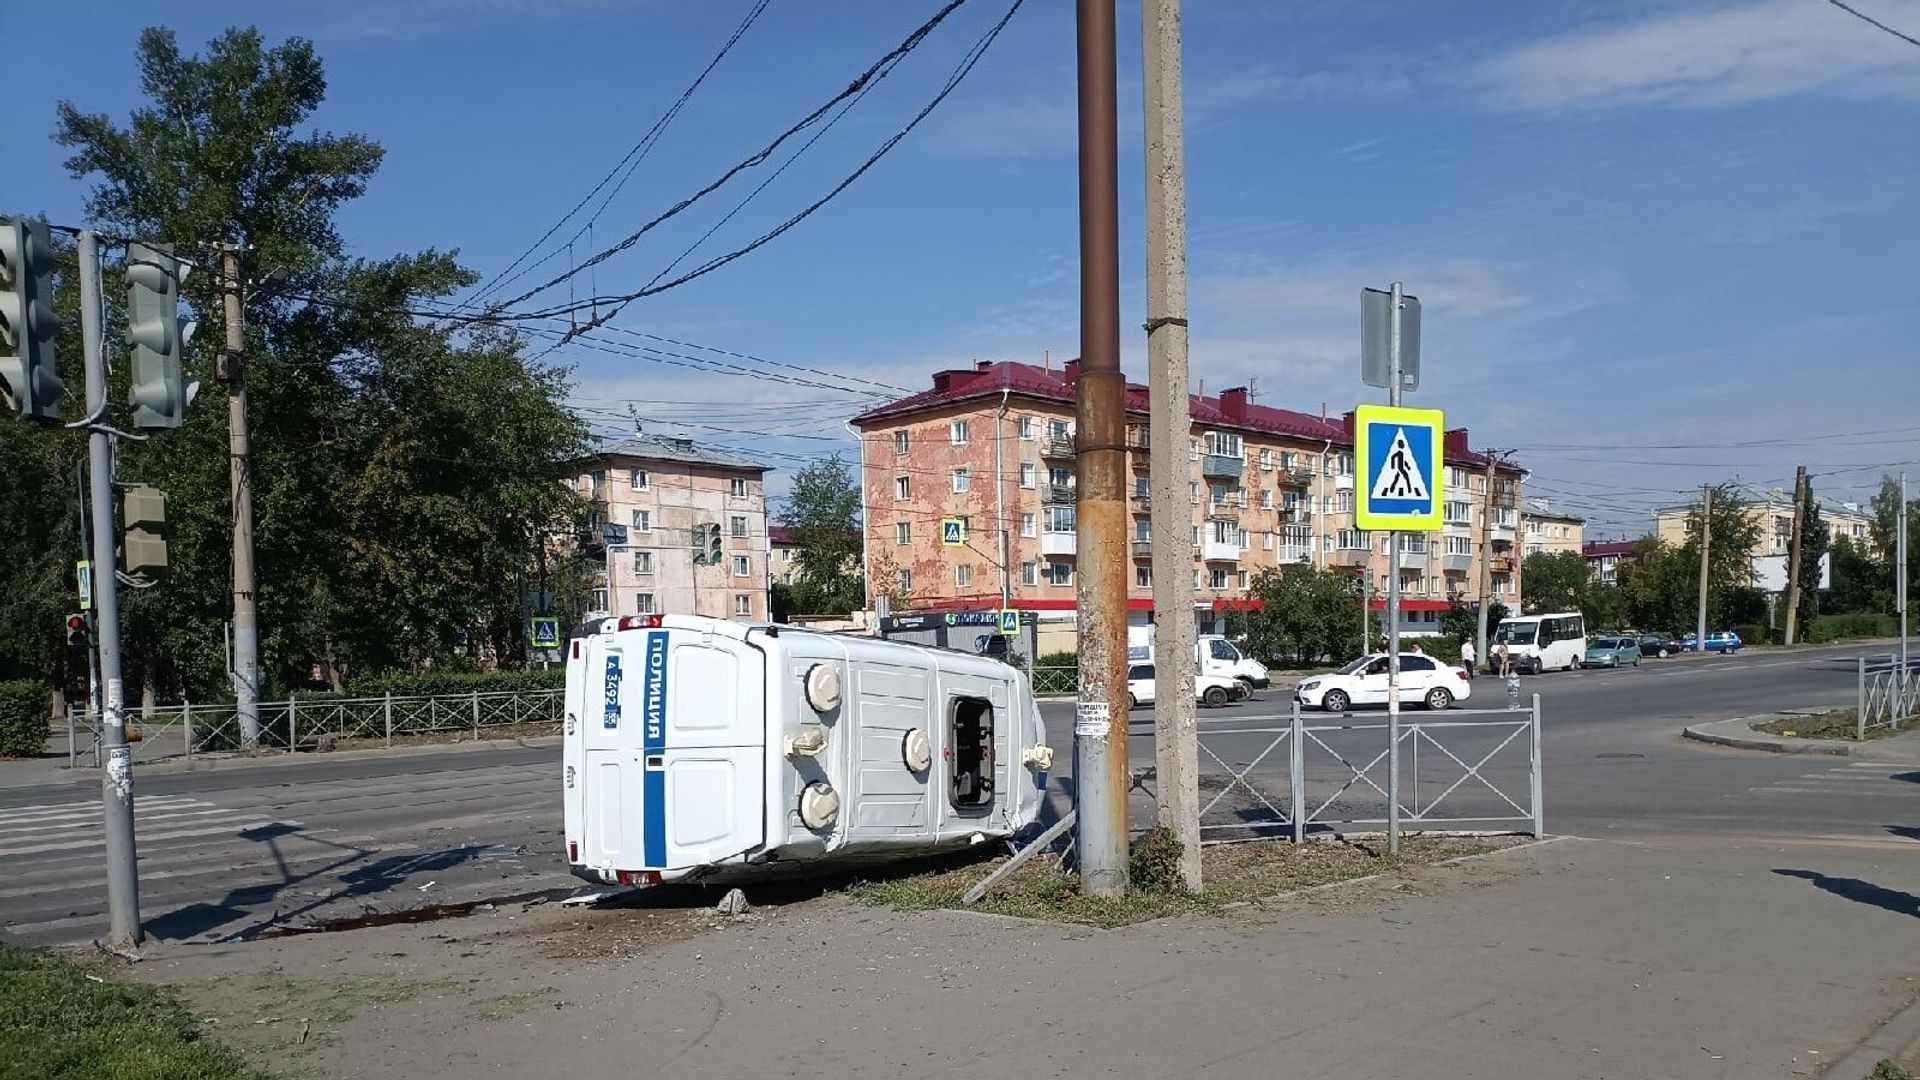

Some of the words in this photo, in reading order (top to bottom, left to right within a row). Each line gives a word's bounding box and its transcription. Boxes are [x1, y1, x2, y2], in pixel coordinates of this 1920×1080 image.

[607, 661, 616, 669] А
[605, 673, 617, 705] 3492
[648, 638, 663, 739] ПОЛИЦИЯ
